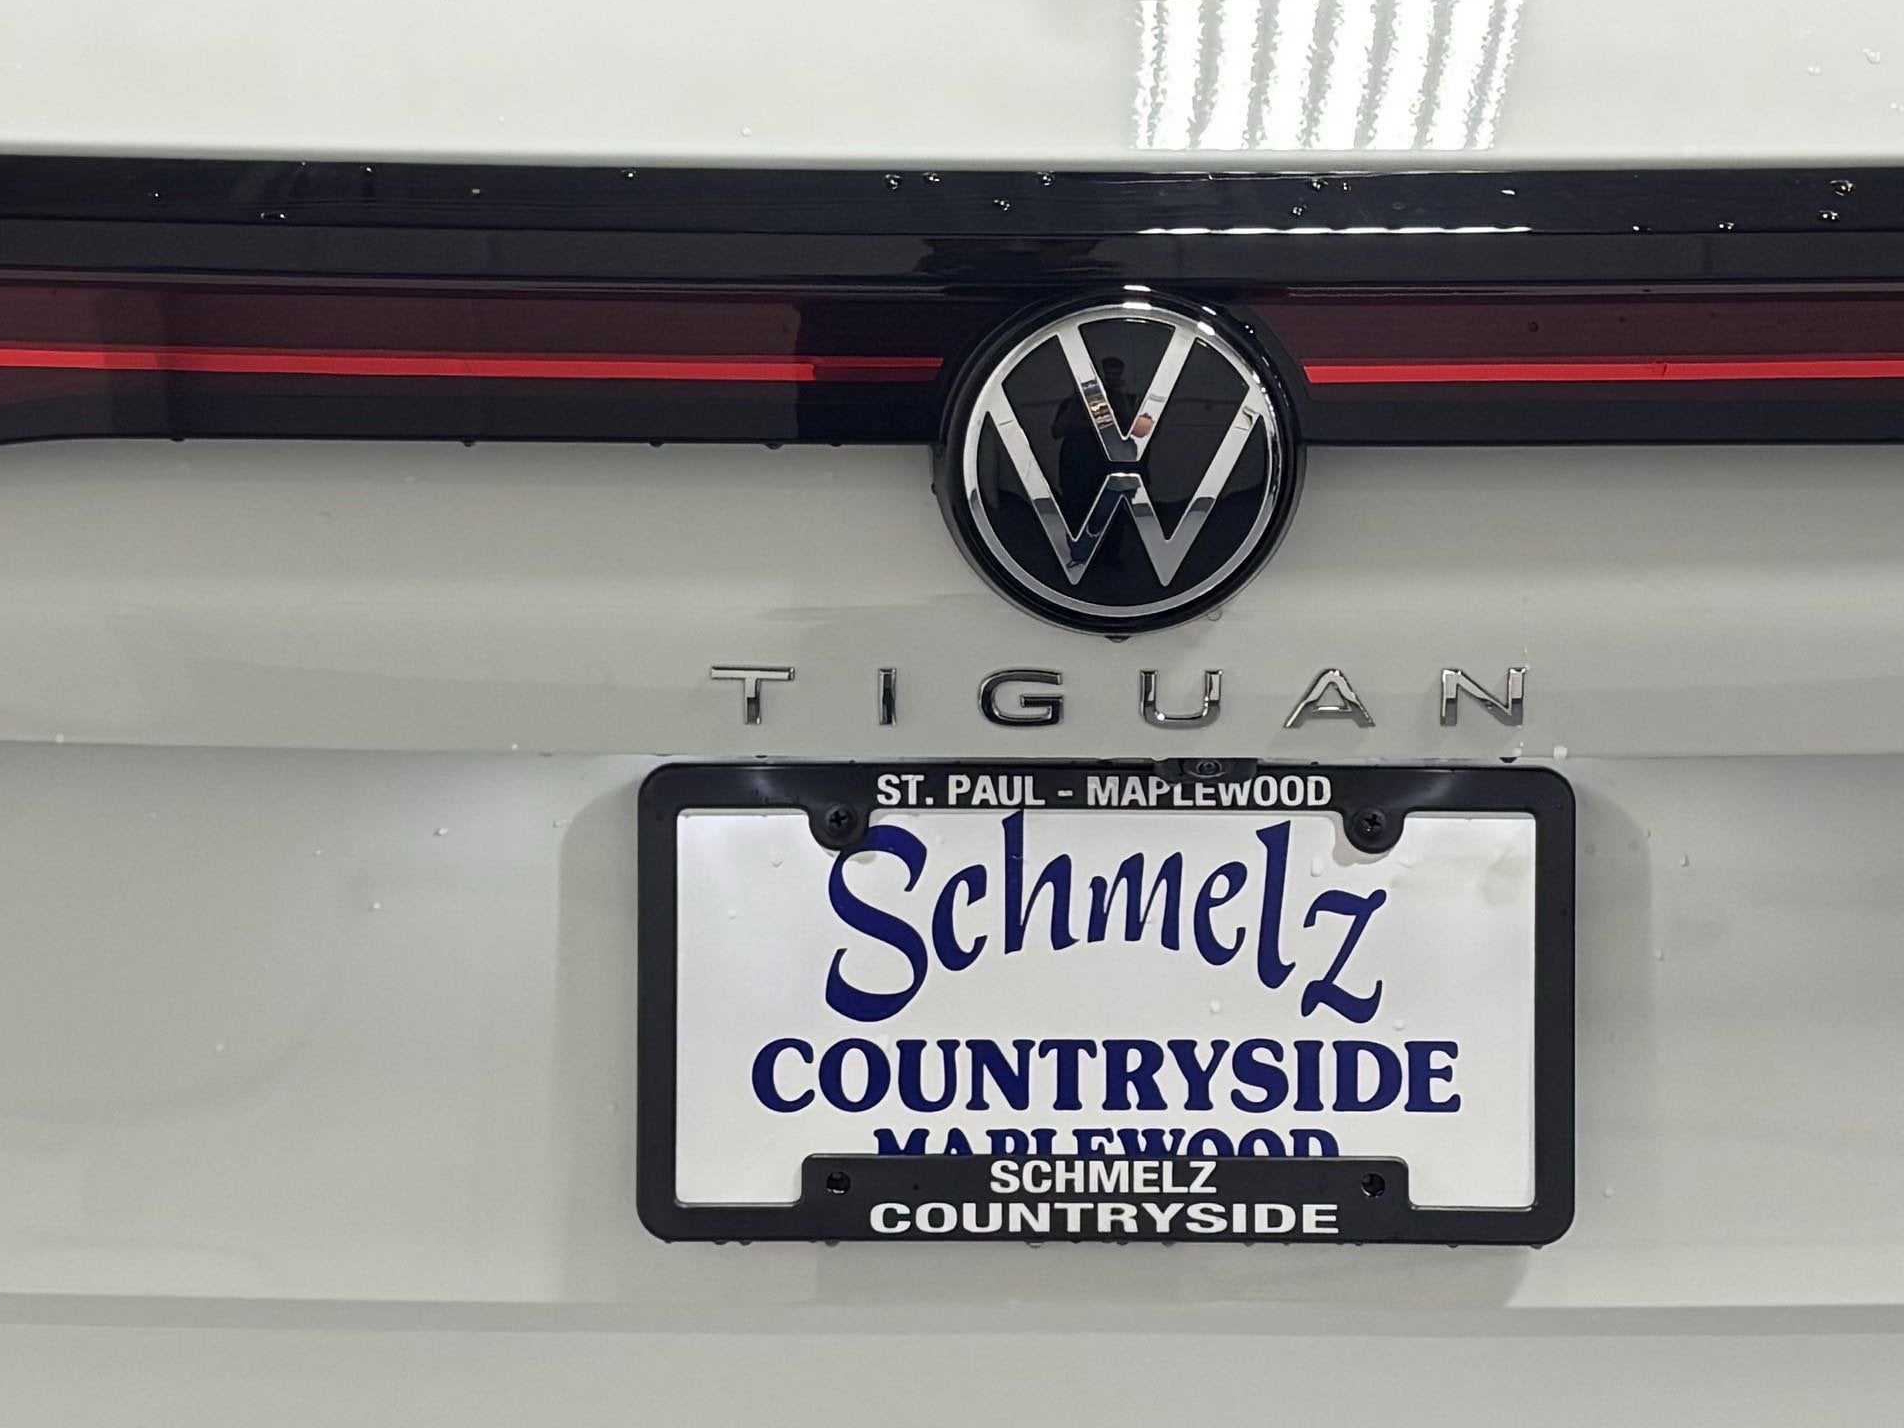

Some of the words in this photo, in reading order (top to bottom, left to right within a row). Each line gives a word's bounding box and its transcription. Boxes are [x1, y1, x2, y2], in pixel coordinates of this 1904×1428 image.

[710, 666, 1528, 729] TIGUAN
[876, 774, 935, 806] ST.
[948, 775, 1046, 806] PAUL
[1087, 775, 1332, 807] MAPLEWOOD
[825, 809, 1387, 1024] Schmelz
[751, 1038, 1462, 1113] COUNTRYSIDE
[990, 1160, 1218, 1194] SCHMELZ
[869, 1202, 1340, 1234] COUNTRYSIDE
